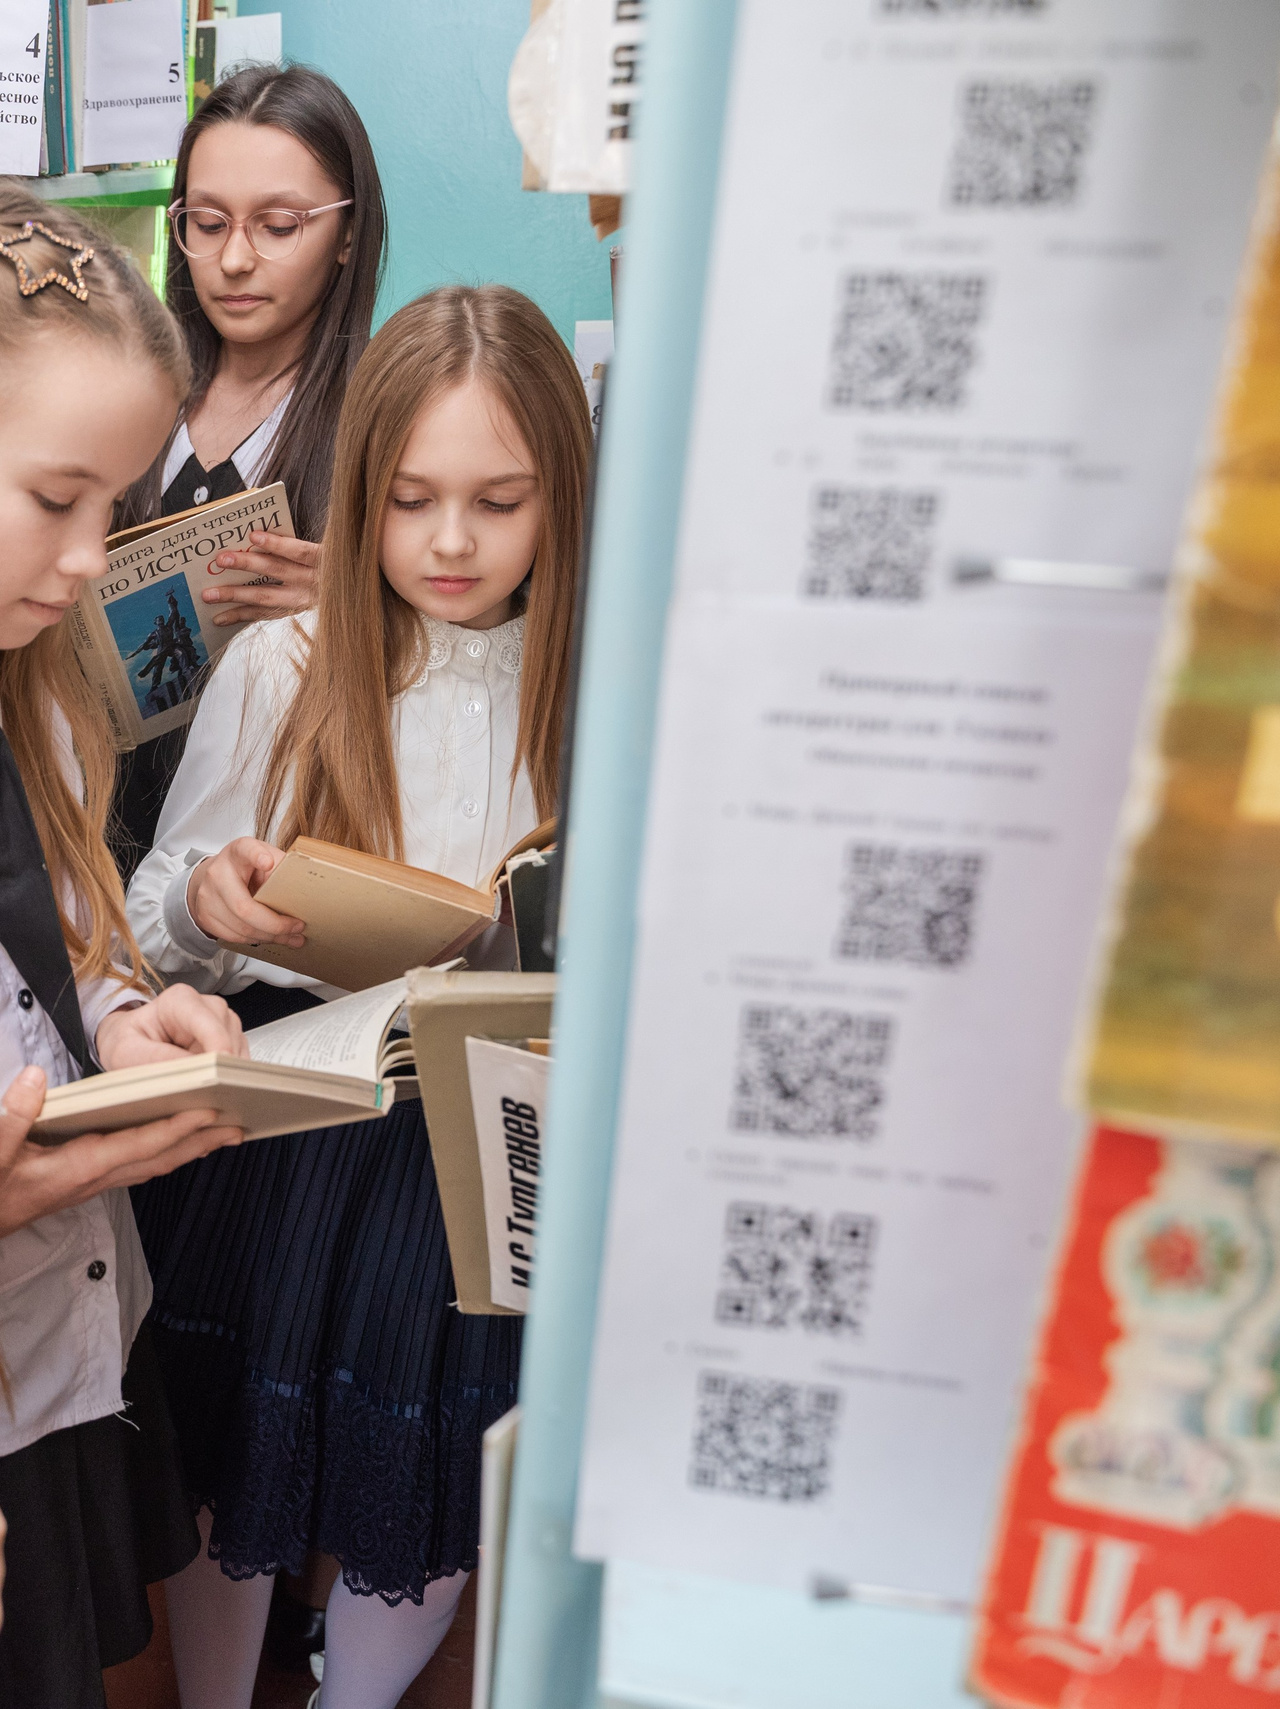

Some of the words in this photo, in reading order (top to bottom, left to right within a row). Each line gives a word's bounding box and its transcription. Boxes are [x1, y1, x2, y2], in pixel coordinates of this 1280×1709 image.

[25, 32, 41, 58] 4
[169, 63, 180, 83] 5
[82, 94, 183, 112] Здравоохранение
[104, 546, 155, 574] нига
[161, 526, 198, 551] для
[202, 495, 277, 530] чтения
[133, 510, 282, 584] ИСТОРИИ
